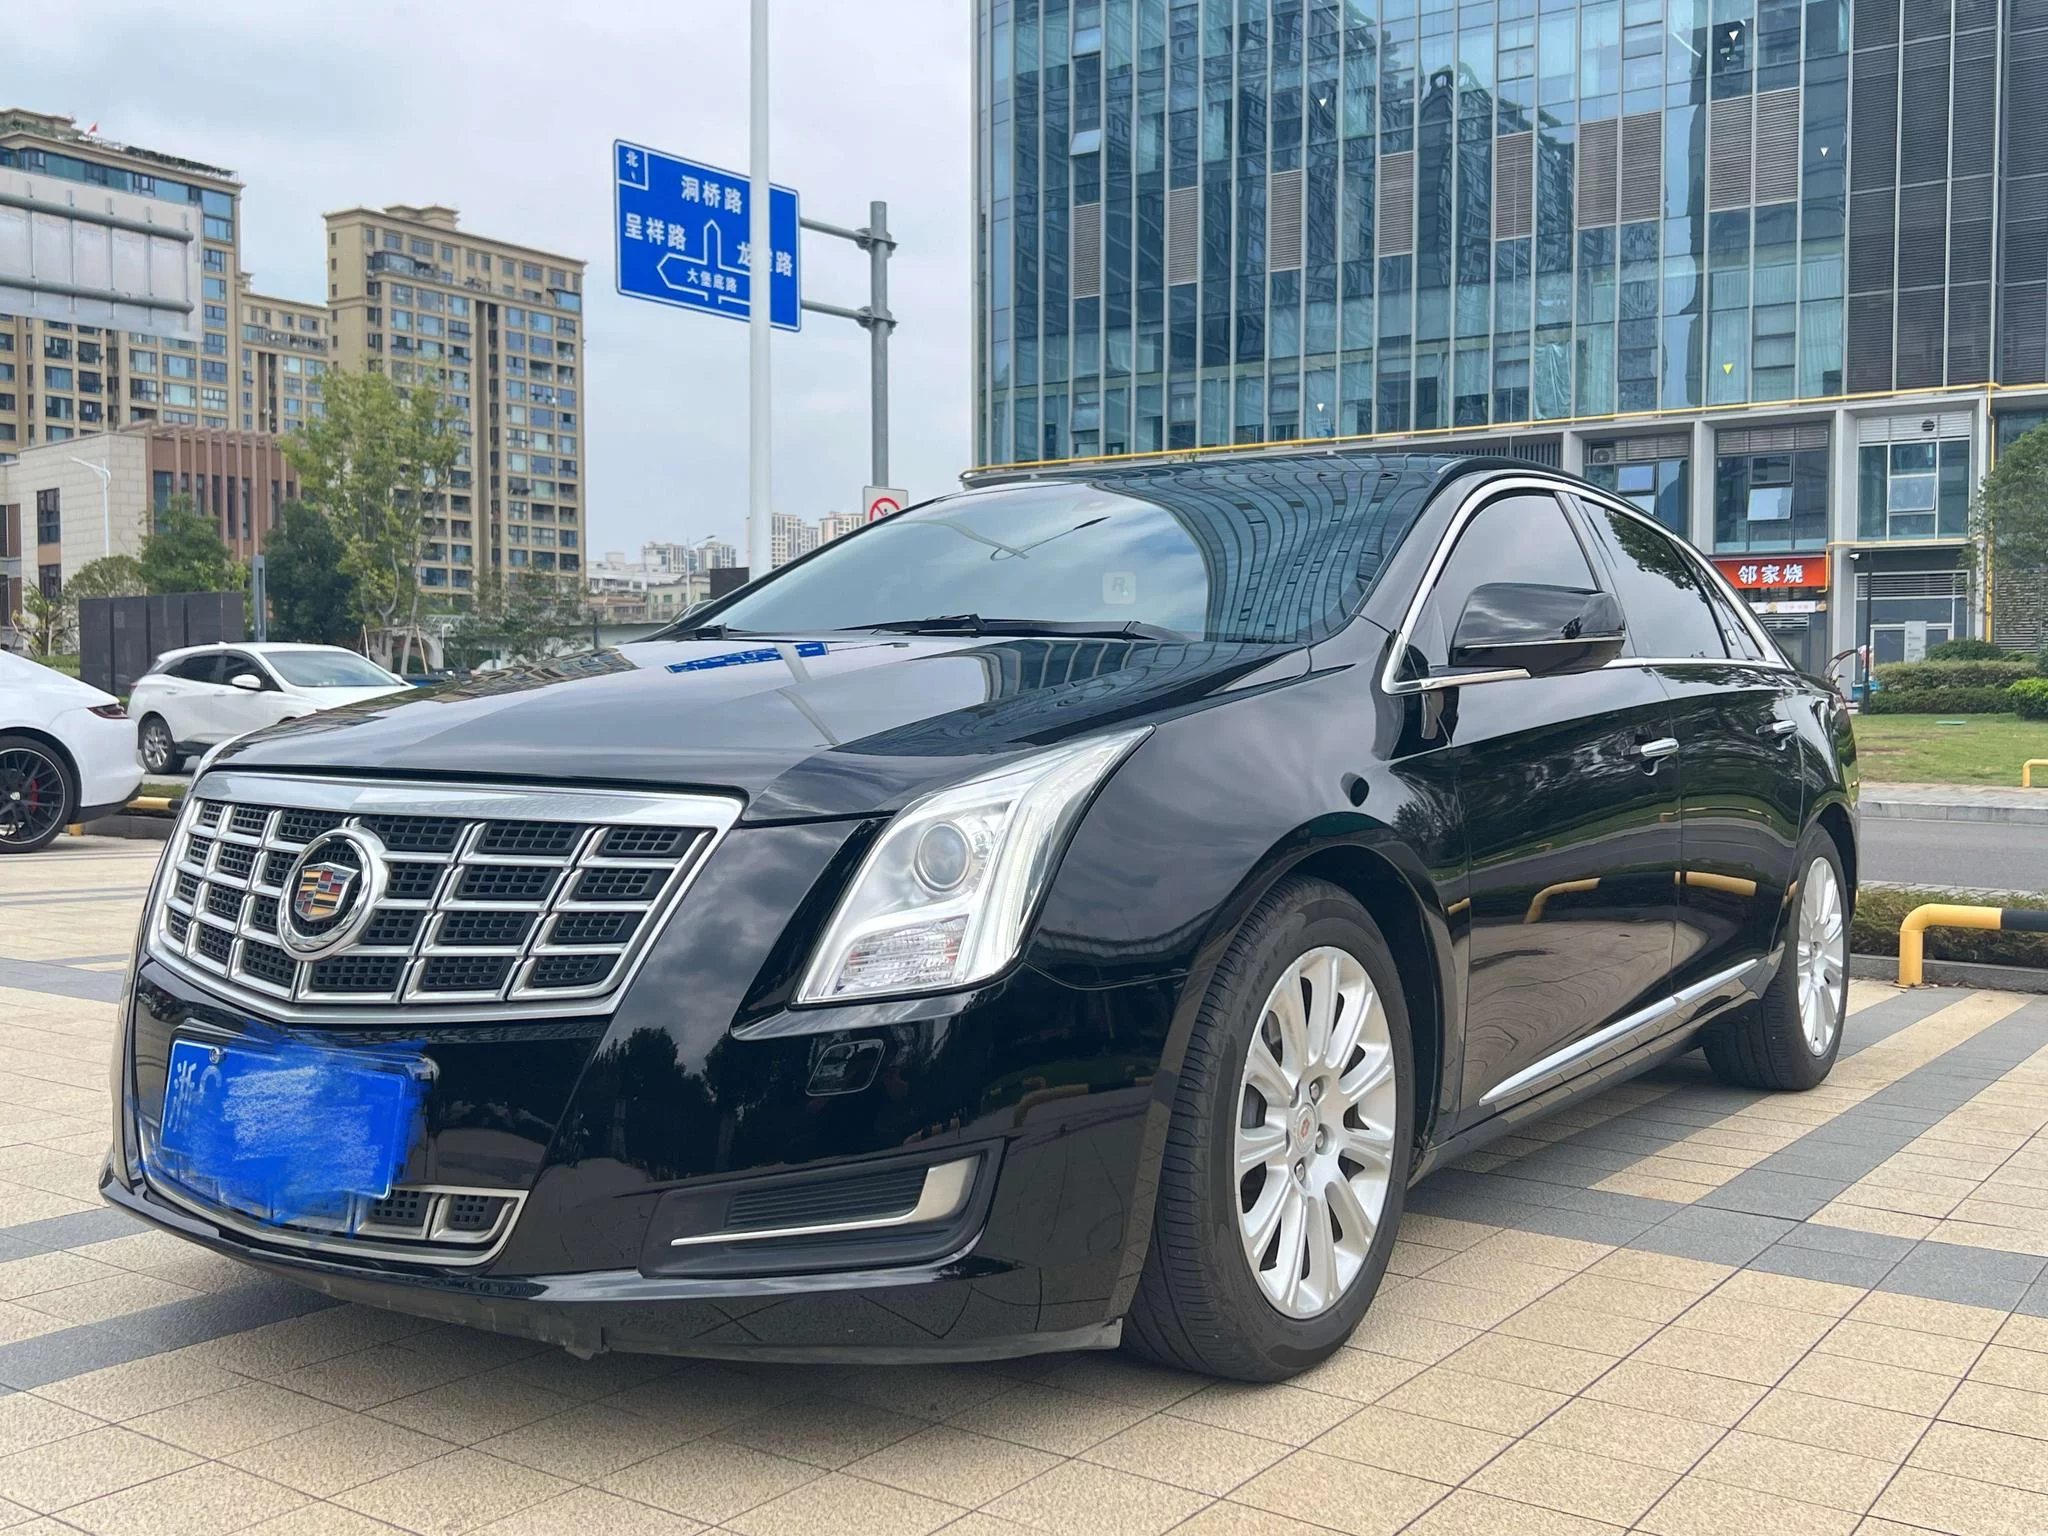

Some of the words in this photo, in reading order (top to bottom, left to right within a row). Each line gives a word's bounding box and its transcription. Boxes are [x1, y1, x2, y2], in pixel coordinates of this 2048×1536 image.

[625, 150, 640, 168] 北
[680, 175, 743, 215] 洞桥路
[624, 212, 687, 251] 呈祥路
[736, 241, 793, 277] 龙路
[1738, 564, 1804, 584] 邻家烧
